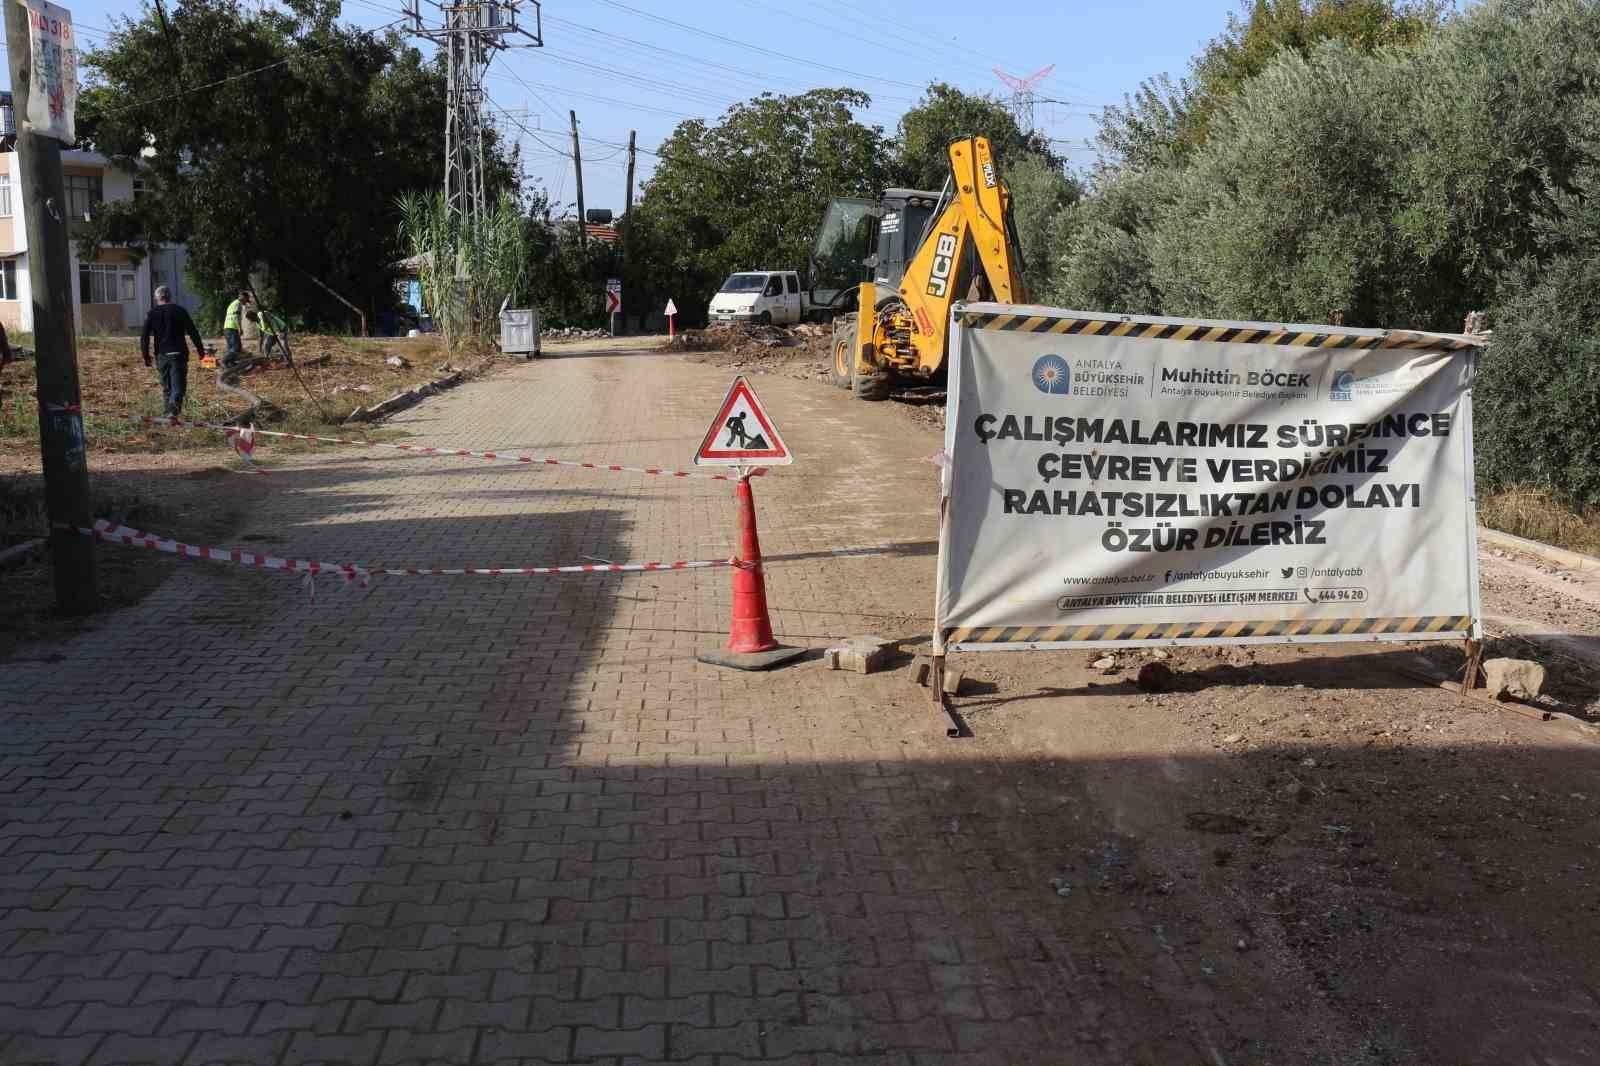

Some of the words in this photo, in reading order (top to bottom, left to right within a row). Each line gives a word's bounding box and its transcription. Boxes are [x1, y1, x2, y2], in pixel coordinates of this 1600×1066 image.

[927, 233, 957, 297] JCB
[1075, 359, 1122, 370] ANTALYA
[1074, 370, 1145, 385] BÜYÜKŞEHİR
[1161, 367, 1240, 385] Muhittin
[1246, 369, 1311, 388] BÖCEK
[1073, 385, 1129, 398] BELEDİYESİ
[974, 413, 1268, 448] ÇALIŞMALARIMIZ
[1037, 452, 1197, 484] ÇEVREYE
[1003, 487, 1292, 517] RAHATSIZLIKTAN
[1296, 483, 1420, 509] DOLAYI
[1101, 521, 1198, 553] ÖZÜR
[1203, 514, 1327, 549] DİLERİZ
[1063, 573, 1155, 586] www.antalya.bel.tr
[1311, 567, 1363, 579] /antalyabb
[1062, 596, 1105, 609] ANTALYA
[1165, 592, 1217, 605] BELEDİYESİ
[1318, 590, 1337, 601] 444
[1338, 590, 1350, 600] 94
[1351, 589, 1364, 600] 20
